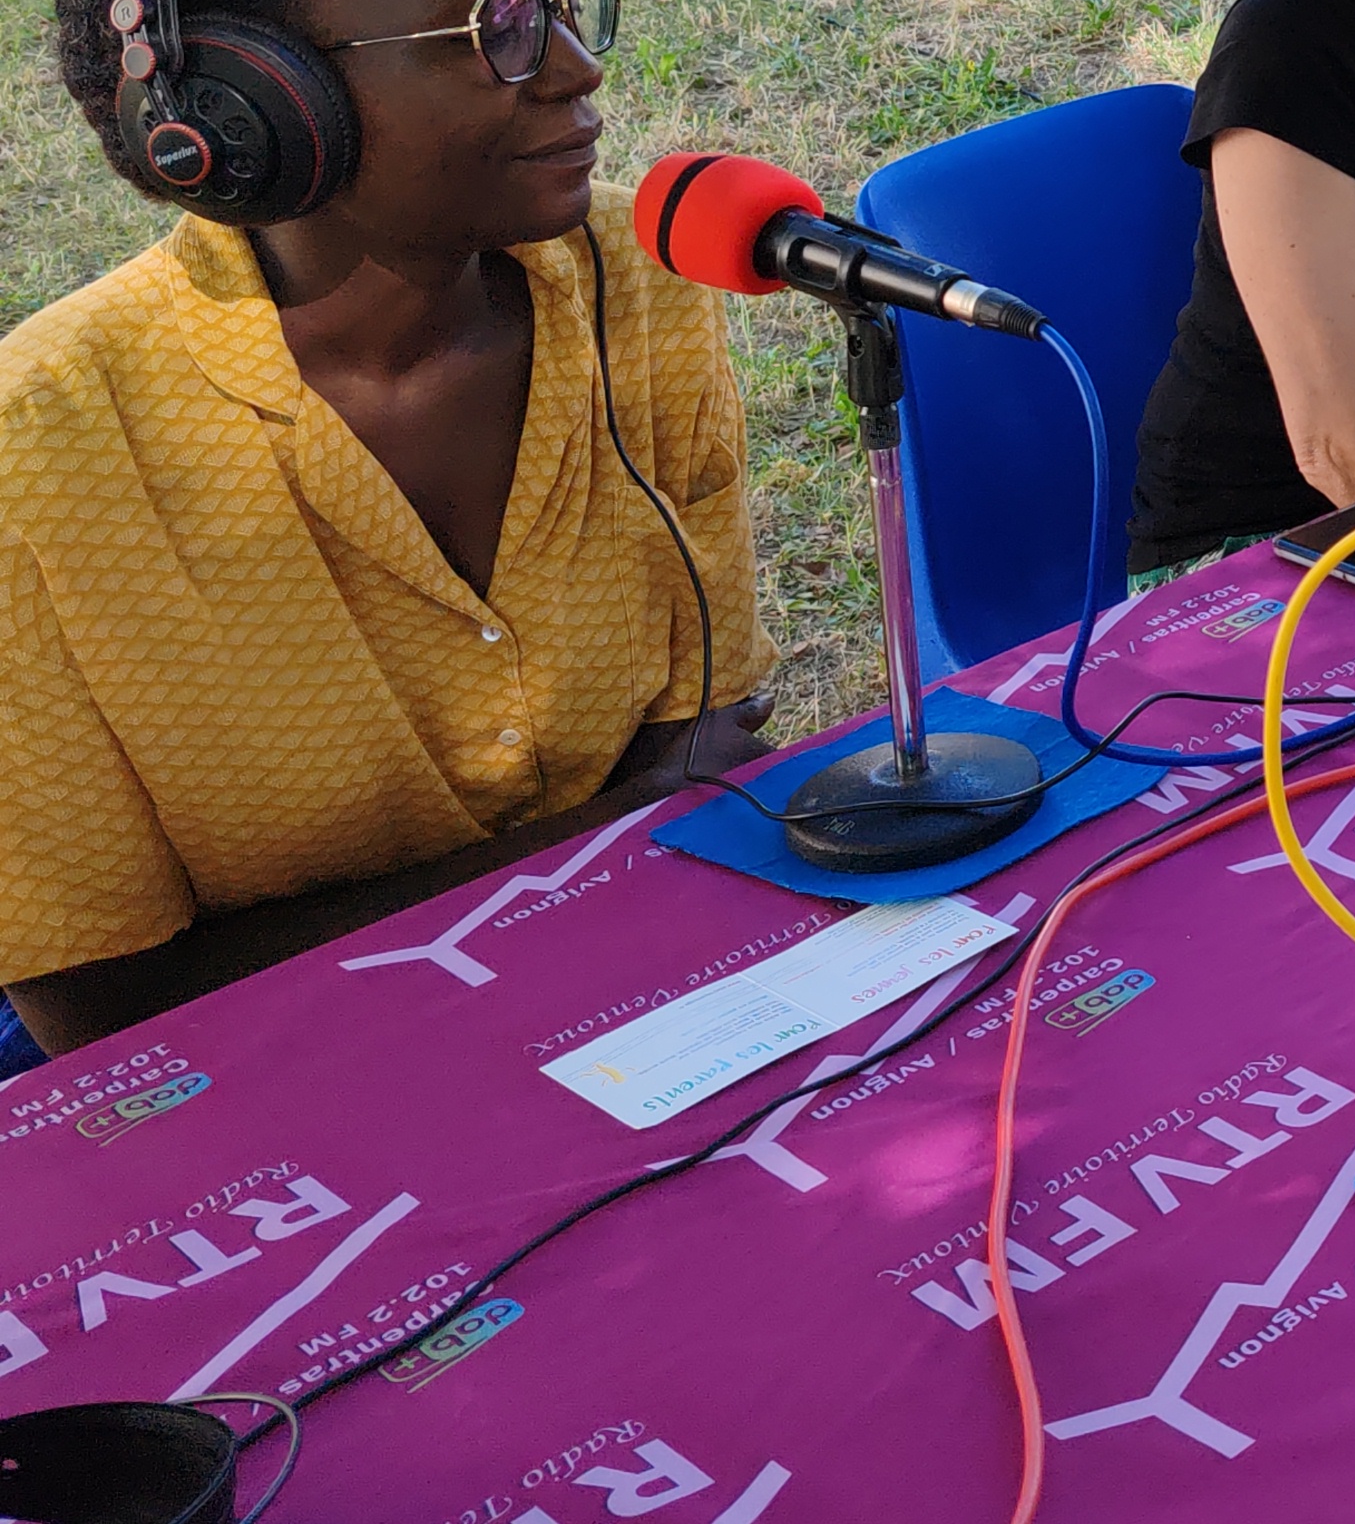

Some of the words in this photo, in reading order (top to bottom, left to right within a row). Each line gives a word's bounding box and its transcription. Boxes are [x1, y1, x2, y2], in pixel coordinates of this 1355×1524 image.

[155, 145, 197, 166] Superlux
[1142, 592, 1262, 643] Carpentras
[1145, 607, 1180, 627] FM
[1181, 584, 1241, 609] 102.2
[492, 869, 612, 930] Avignon
[686, 910, 831, 984] Territoire
[918, 946, 955, 967] les
[522, 987, 679, 1057] Ventoux
[966, 957, 1124, 1040] Carpenras
[973, 987, 1018, 1014] FM
[72, 1042, 171, 1088] 102.2
[736, 1042, 775, 1061] les
[1197, 1052, 1287, 1106] Radio
[10, 1087, 64, 1119] FM
[810, 1053, 936, 1122] Avignon
[1043, 1106, 1195, 1194] Territoire
[185, 1161, 299, 1220] Radio
[0, 1217, 173, 1306] Territoir
[76, 1176, 352, 1332] RTV
[876, 1197, 1039, 1284] Vntoux
[909, 1193, 1138, 1331] FM
[366, 1261, 471, 1323] 102.2
[298, 1323, 359, 1357] FM
[1218, 1281, 1348, 1369] Avignon
[522, 1419, 646, 1490] Radio
